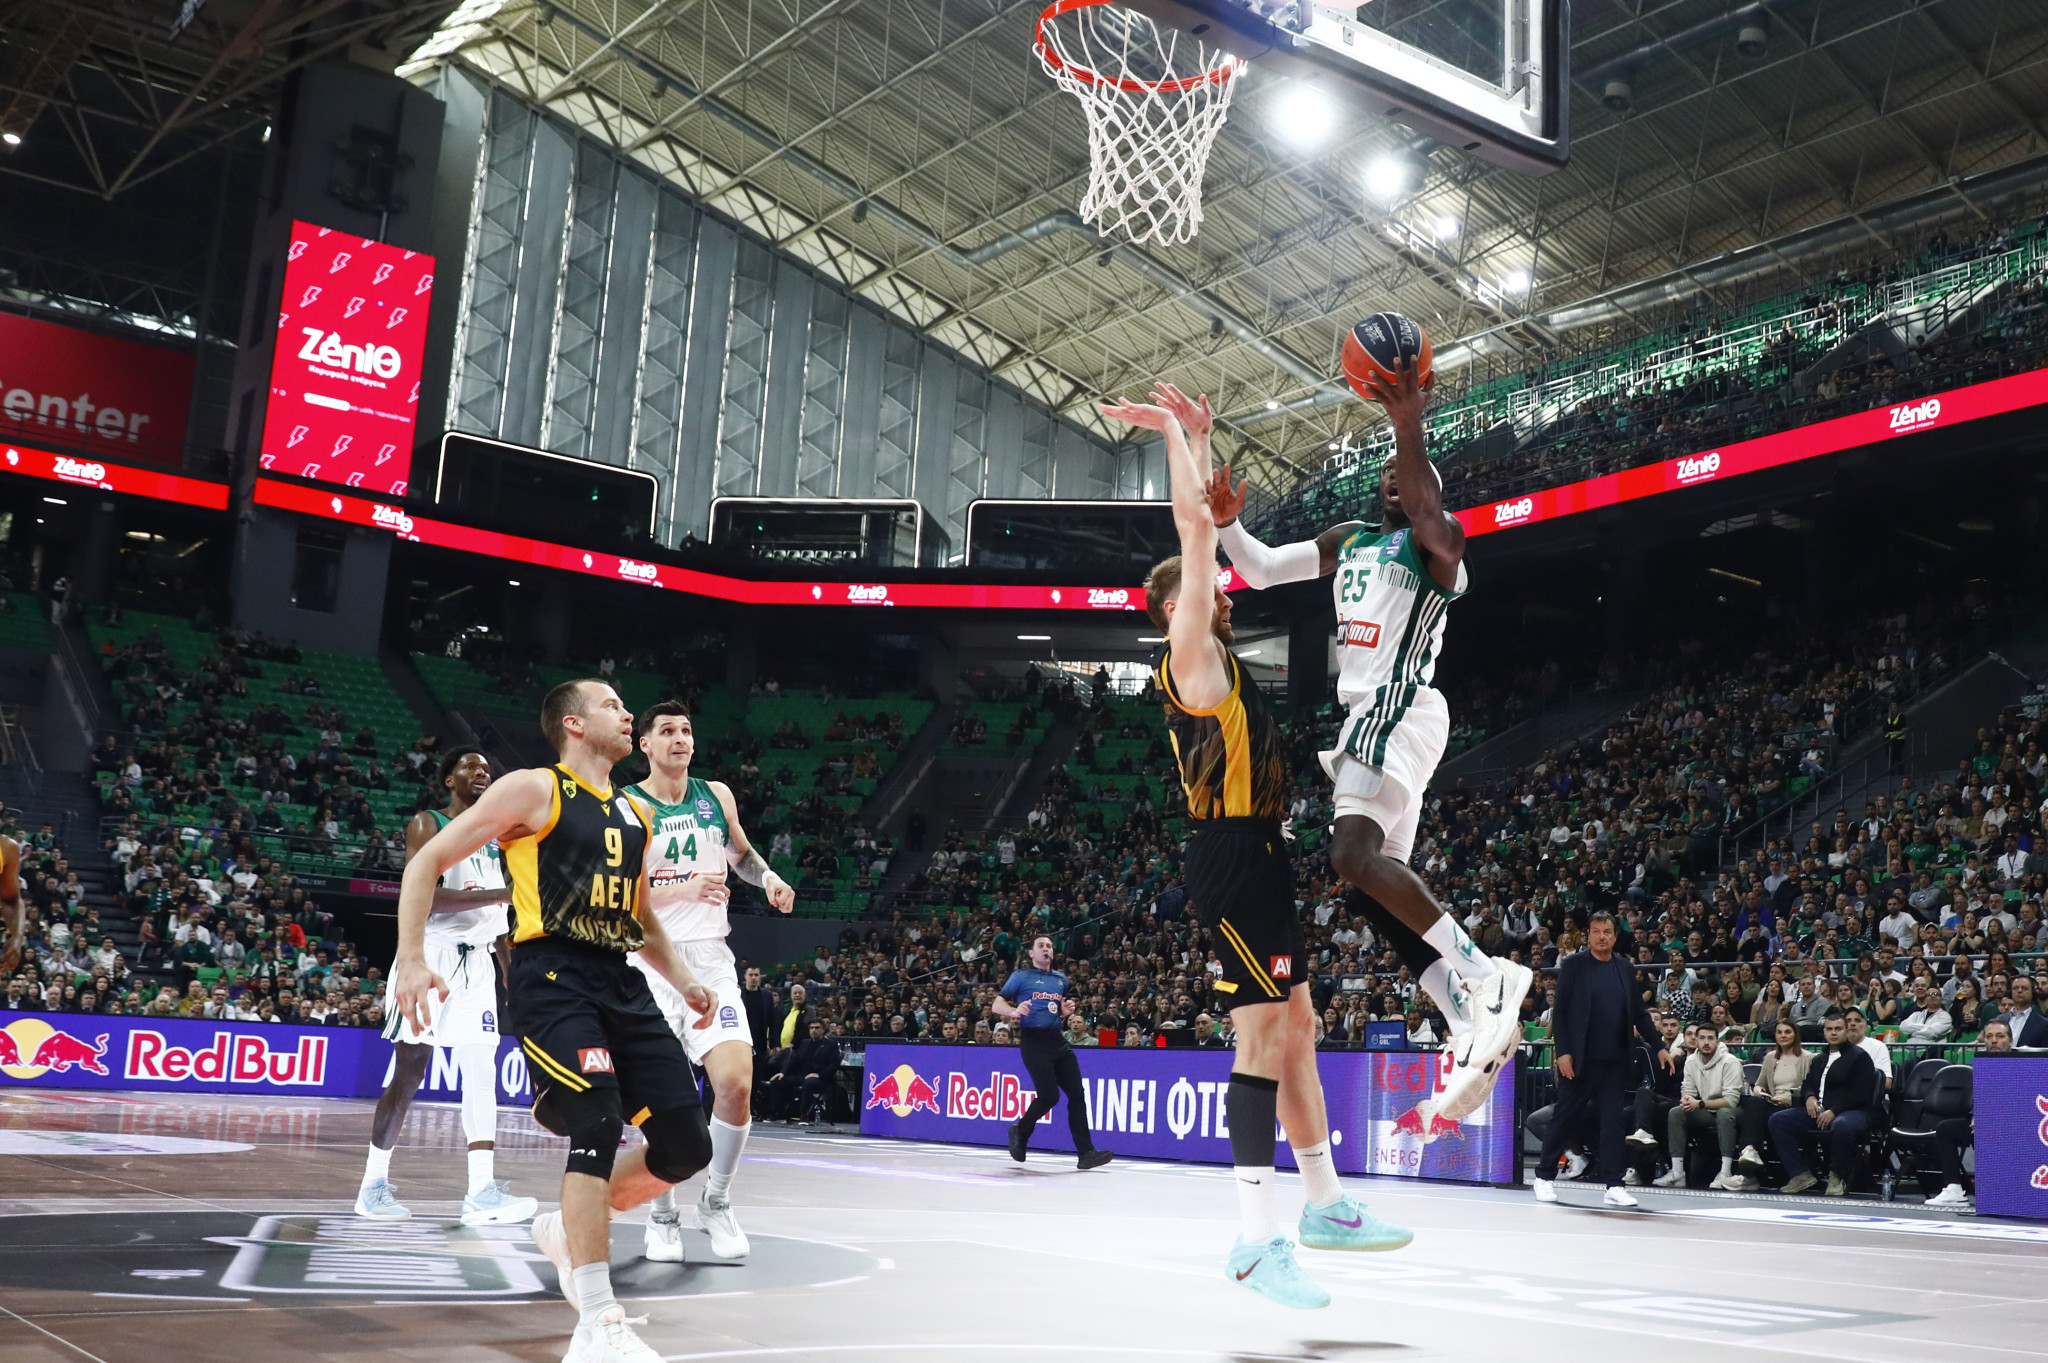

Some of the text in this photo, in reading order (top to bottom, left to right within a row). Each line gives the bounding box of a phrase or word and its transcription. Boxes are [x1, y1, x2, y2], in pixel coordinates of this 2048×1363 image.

[0, 379, 149, 443] enter
[1341, 569, 1371, 603] 25
[604, 827, 623, 868] 9
[664, 833, 698, 864] 44
[124, 1030, 232, 1082] Red
[230, 1035, 329, 1086] Bull
[1373, 1053, 1427, 1093] Red
[946, 1071, 1053, 1124] Red Bu
